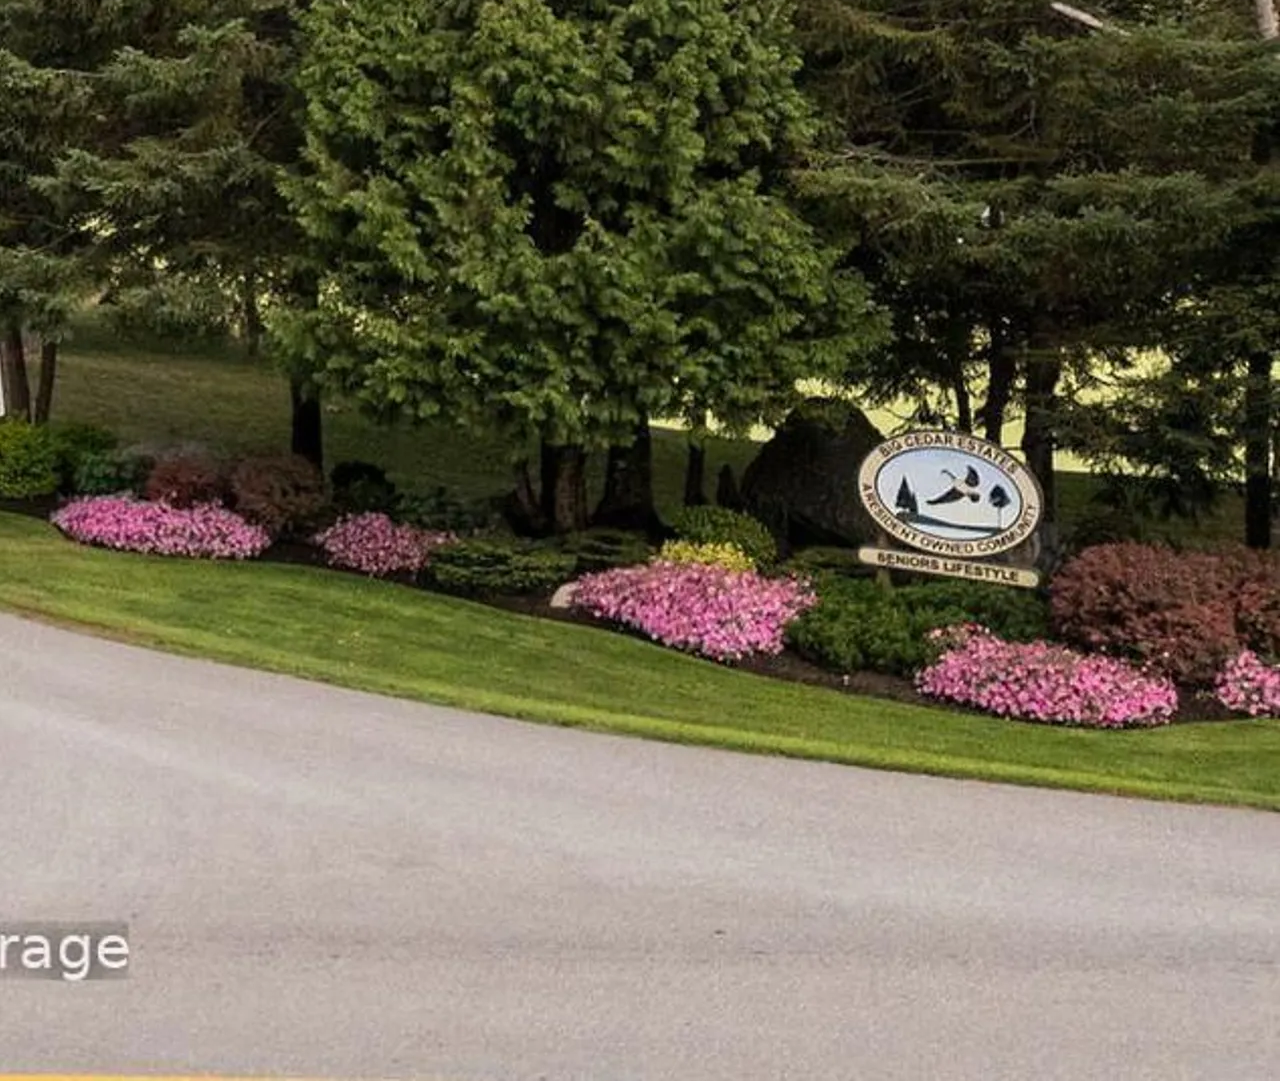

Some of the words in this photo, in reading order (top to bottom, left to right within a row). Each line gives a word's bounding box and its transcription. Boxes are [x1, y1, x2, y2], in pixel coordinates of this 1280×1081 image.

[879, 439, 902, 458] BIG
[904, 434, 953, 448] CEDAR
[958, 438, 1019, 475] ESTATES
[862, 492, 920, 543] RESIDENT
[920, 536, 974, 555] OWNED
[977, 504, 1038, 552] COMMUNITY
[877, 552, 940, 571] SENIORS
[943, 562, 1020, 583] LIFESTYLE
